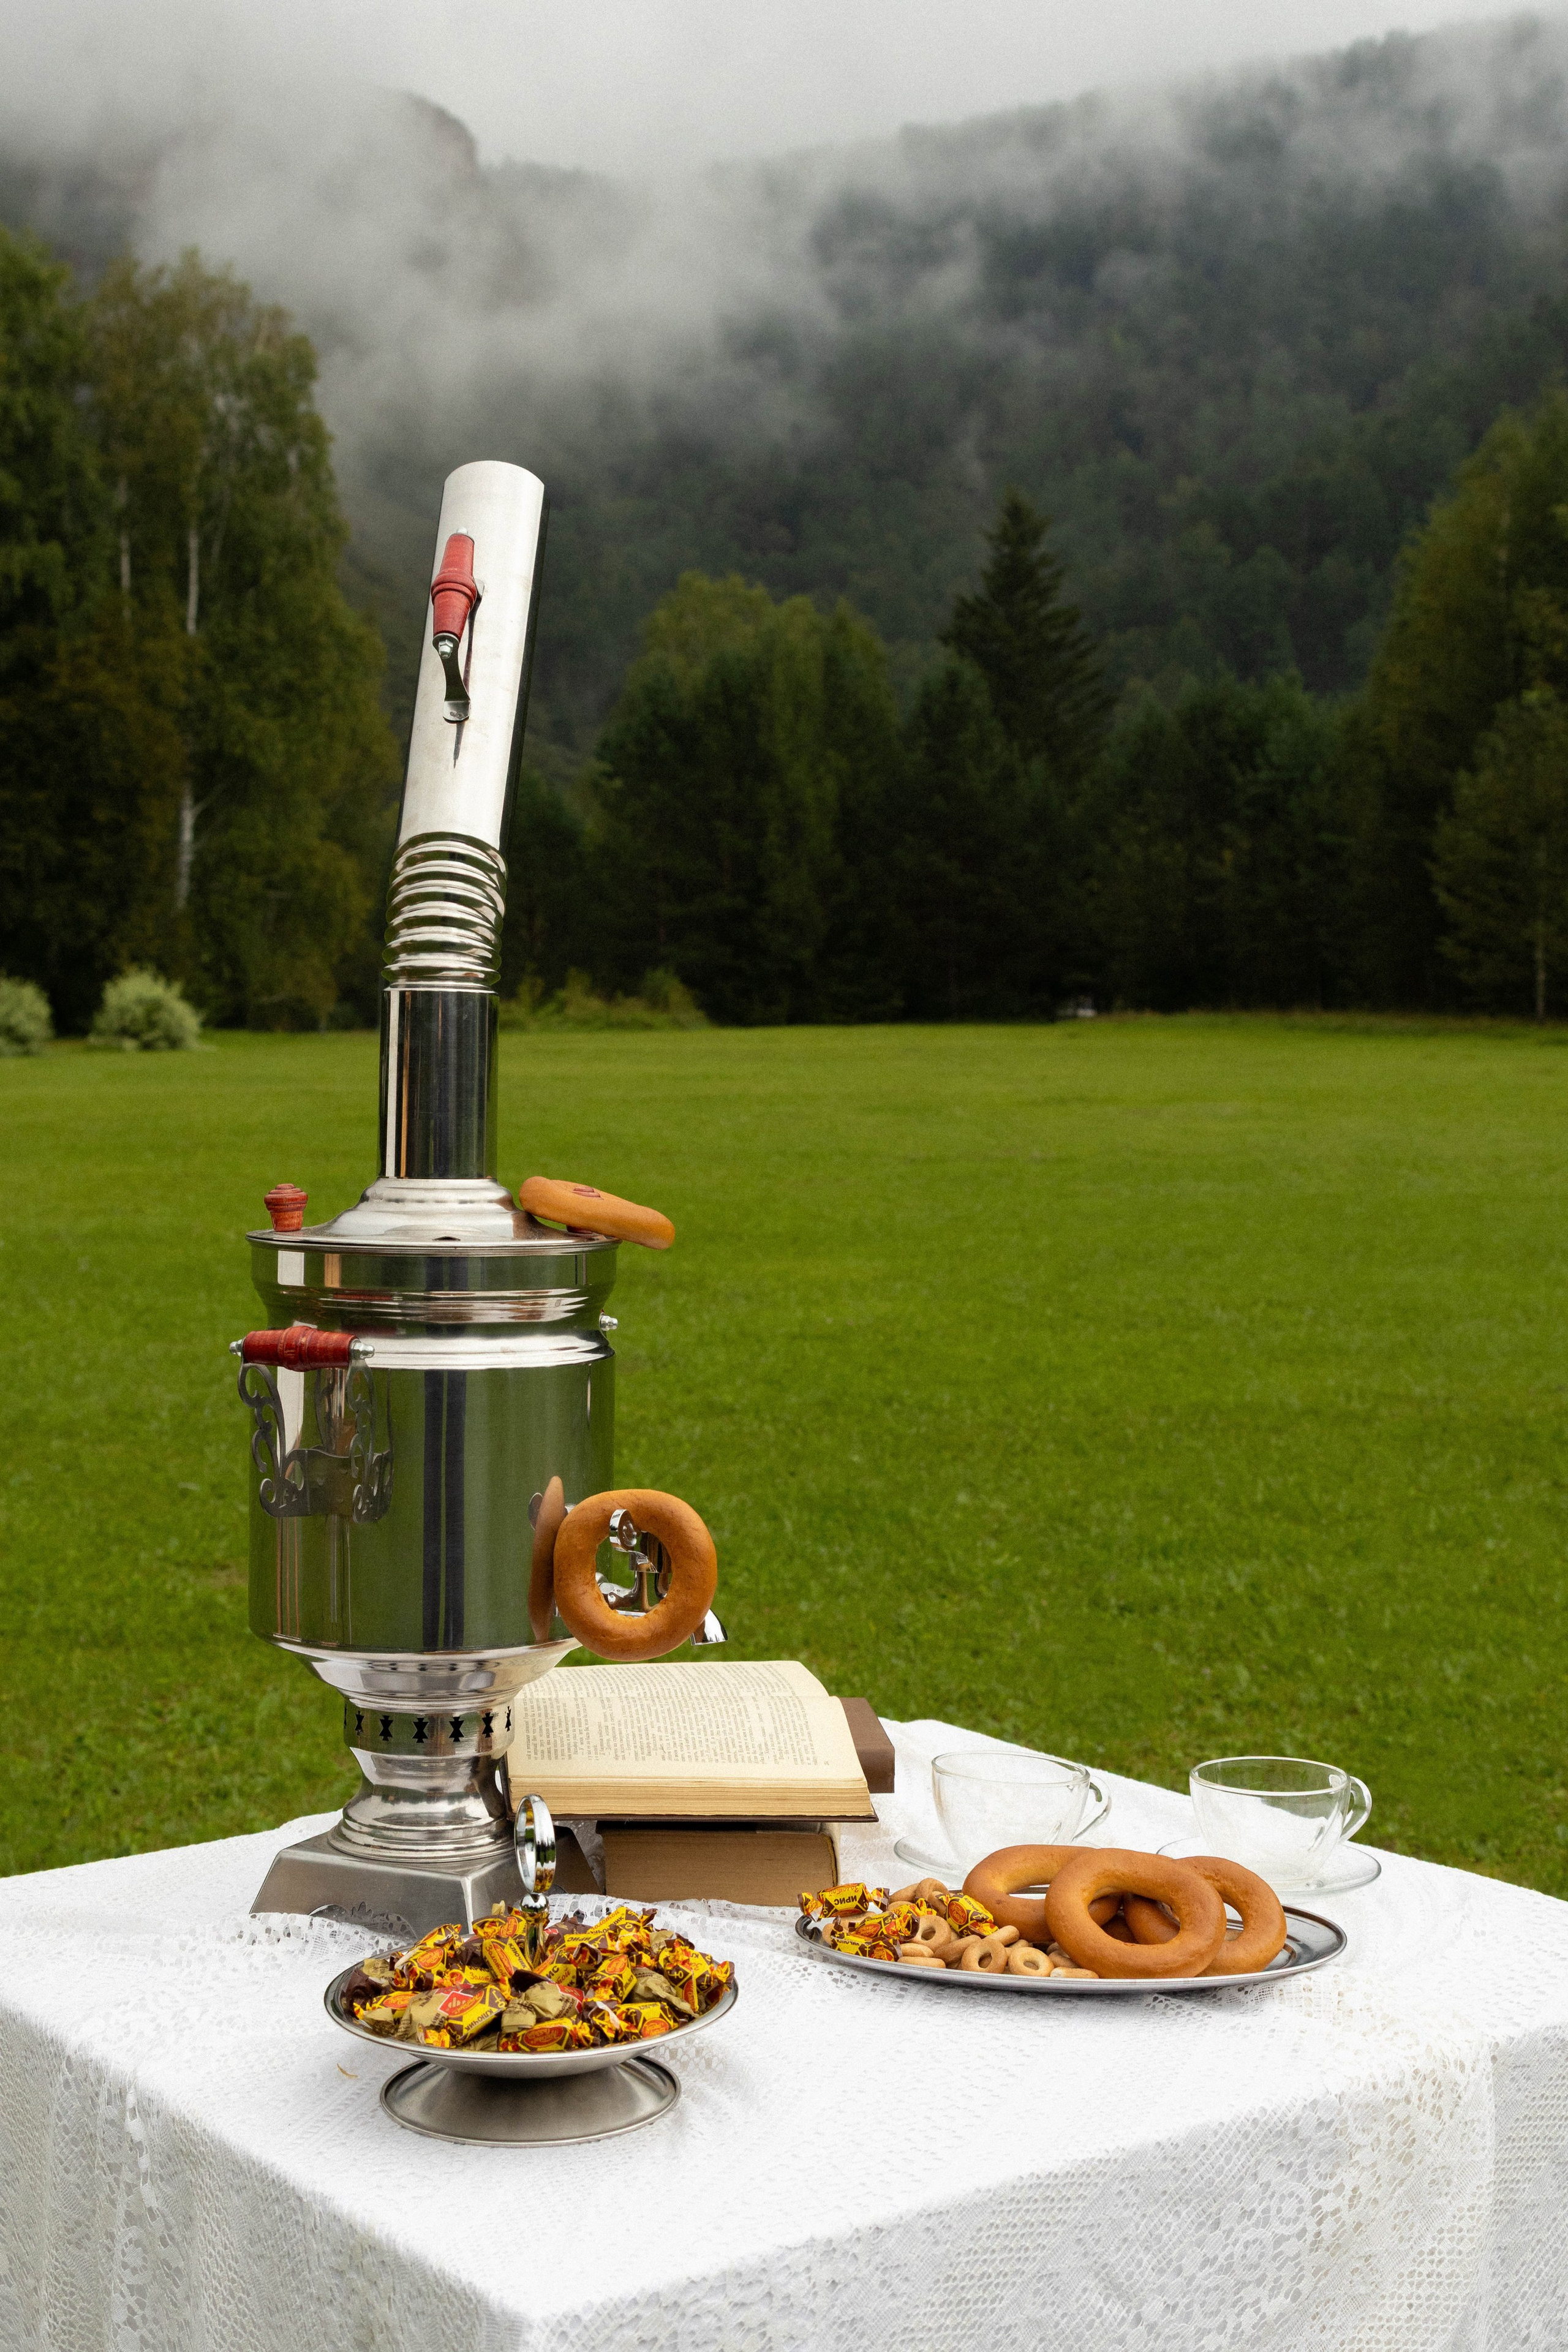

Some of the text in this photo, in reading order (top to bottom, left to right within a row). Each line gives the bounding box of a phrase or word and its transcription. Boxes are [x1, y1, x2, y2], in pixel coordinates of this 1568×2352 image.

[834, 1895, 858, 1905] ИРИС
[508, 1943, 527, 1969] КЛЮЧИК
[464, 2009, 494, 2031] КЛЮЧИК
